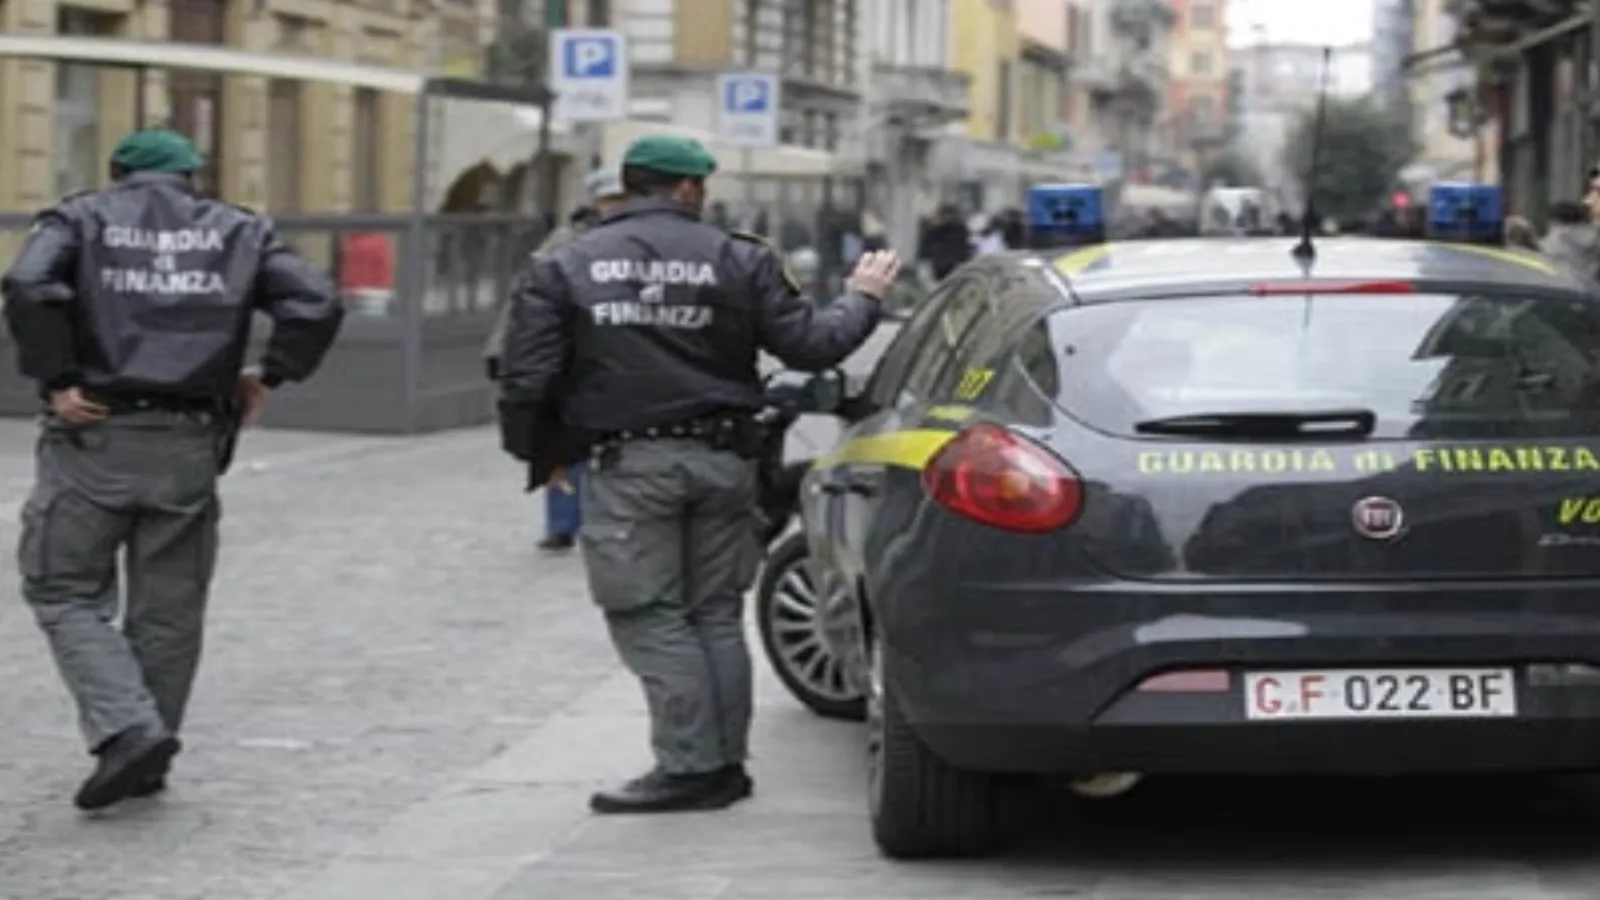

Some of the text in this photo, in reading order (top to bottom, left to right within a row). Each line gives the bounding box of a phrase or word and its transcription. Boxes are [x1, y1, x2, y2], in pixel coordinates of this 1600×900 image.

[575, 39, 609, 76] P
[103, 226, 223, 252] GUARDIA
[101, 268, 226, 295] FINANZA
[590, 258, 717, 286] GUARDIA
[591, 301, 714, 329] FINANZA
[1137, 446, 1600, 474] GUARDIA di FINANZA
[1344, 674, 1432, 711] 022
[1448, 673, 1503, 710] BF
